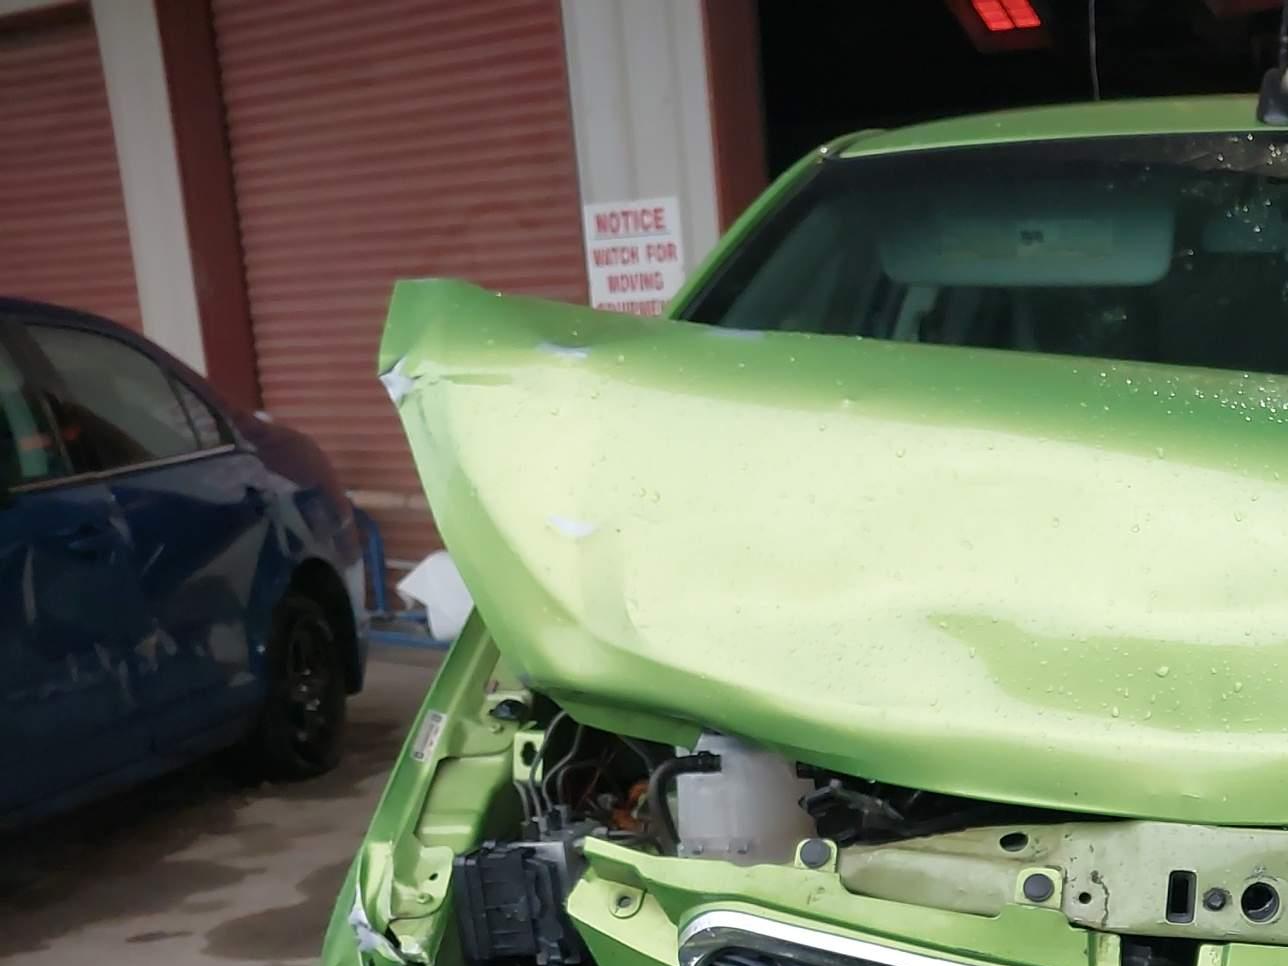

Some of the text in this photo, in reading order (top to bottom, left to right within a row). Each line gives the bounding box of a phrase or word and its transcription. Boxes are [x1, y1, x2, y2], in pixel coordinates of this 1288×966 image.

[595, 207, 666, 234] NOTICE
[593, 242, 679, 267] WATCH FOR
[607, 272, 664, 295] MOVING
